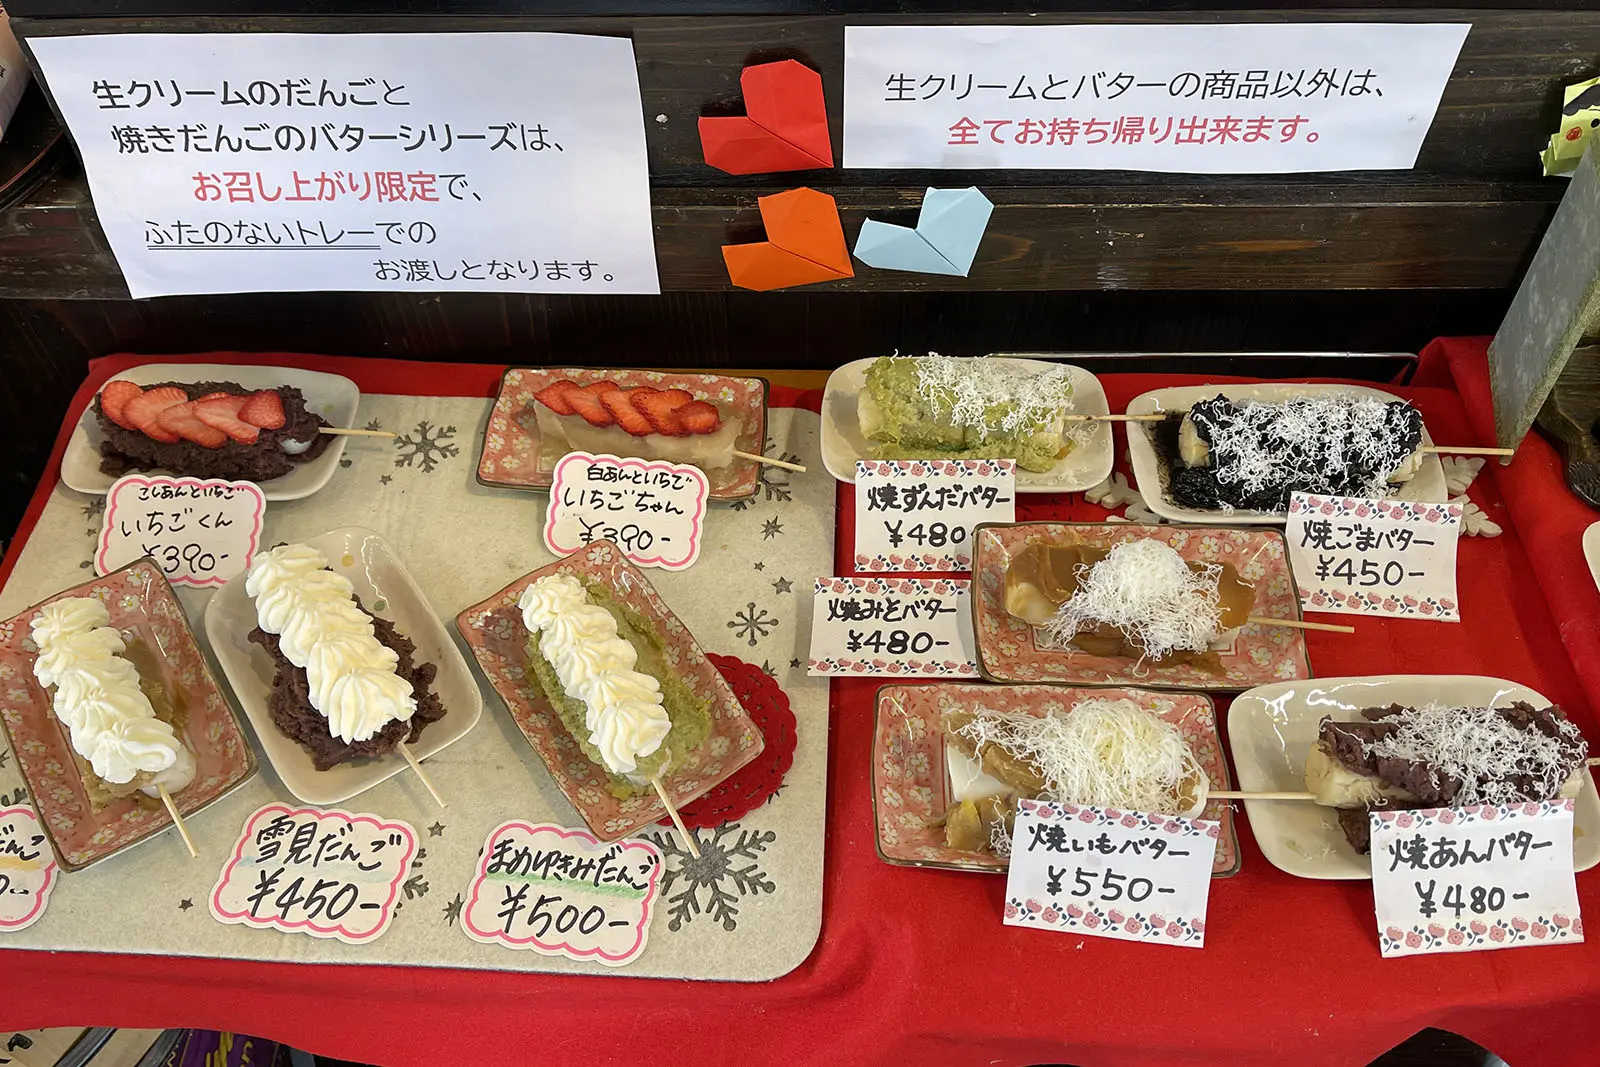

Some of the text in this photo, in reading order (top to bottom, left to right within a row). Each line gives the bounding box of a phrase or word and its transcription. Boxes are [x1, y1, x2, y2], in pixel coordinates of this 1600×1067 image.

[92, 77, 410, 109] 生クリームのだんごと
[884, 68, 1383, 101] 生クリームとバターの商品以外は、
[110, 122, 564, 154] 焼きだんごのバターシリーズは、
[947, 114, 1319, 146] 全てお持ち帰り出来ます。
[192, 170, 482, 203] お召し上がり限定で、
[145, 220, 436, 245] ふたのないトレーでの
[373, 258, 614, 282] お渡しとなります。
[138, 485, 245, 501] こしあんといちご
[586, 463, 693, 491] 白あんといちご
[564, 486, 684, 515] いちごちゃん
[867, 482, 1011, 513] 焼ずんだバター
[121, 507, 233, 538] いちごくん
[883, 519, 975, 549] ¥480
[1300, 518, 1435, 552] 焼ごまバター
[1314, 554, 1425, 587] ¥450-
[826, 596, 957, 623] 焼みそバター
[846, 629, 950, 655] ¥480-
[255, 814, 402, 872] 雪見だんご
[1027, 819, 1190, 860] 焼いもバター
[1388, 830, 1553, 872] 焼あんバター
[487, 837, 660, 891] まめゆきみだんご
[246, 866, 381, 921] ¥450-
[1046, 865, 1176, 905] ¥550-
[1414, 879, 1530, 918] ¥480-
[497, 881, 630, 938] ¥500-
